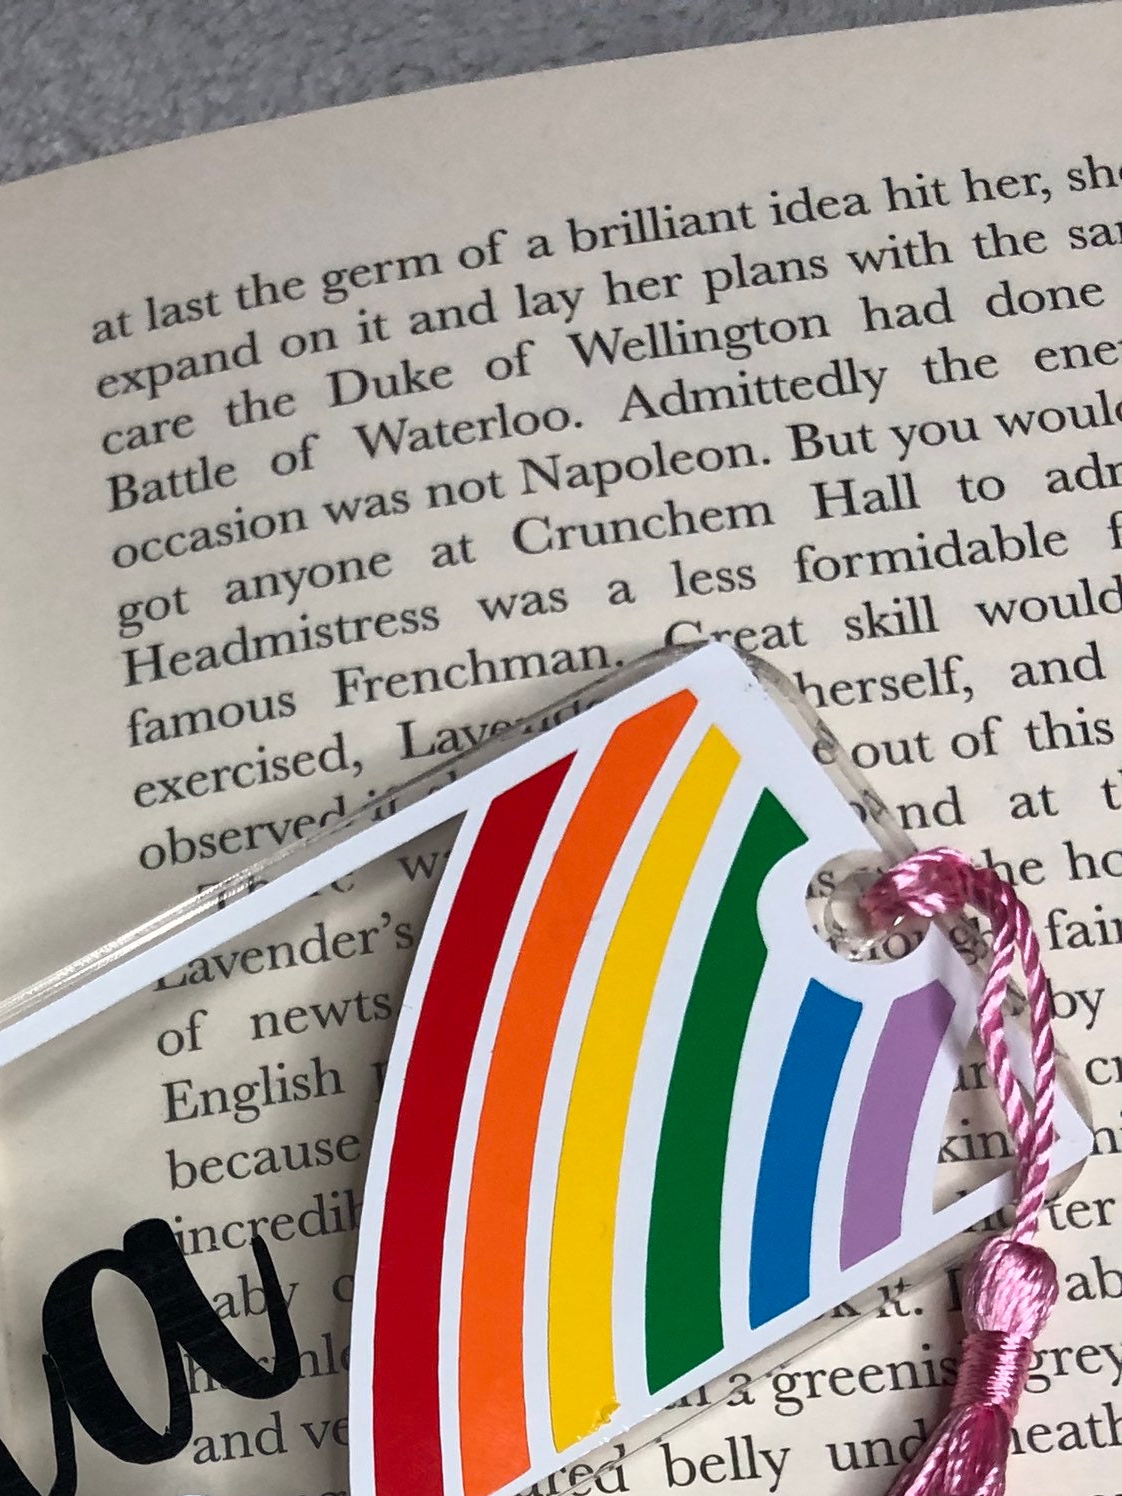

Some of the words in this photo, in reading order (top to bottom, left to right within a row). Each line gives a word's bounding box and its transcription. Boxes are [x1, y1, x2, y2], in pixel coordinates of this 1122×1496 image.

[96, 329, 262, 401] expand
[514, 282, 585, 324] lay
[701, 252, 829, 305] plans
[846, 229, 954, 275] with
[971, 222, 1048, 260] the
[144, 290, 222, 332] last
[321, 252, 443, 305] germ
[565, 201, 757, 253] brilliant
[769, 186, 872, 226] idea
[881, 172, 951, 213] hit
[960, 167, 1052, 204] her,
[101, 414, 194, 455] care
[326, 358, 453, 408] Duke
[566, 314, 831, 368] Wellington
[858, 286, 956, 332] had
[985, 279, 1105, 318] done
[106, 455, 237, 513] Battle
[353, 402, 583, 459] Waterloo.
[618, 357, 888, 423] Admittedly
[921, 345, 999, 385] the
[111, 506, 309, 569] occasion
[321, 489, 411, 525] was
[425, 470, 506, 509] not
[517, 440, 771, 498] Napoleon.
[785, 422, 877, 462] But
[889, 417, 981, 462] you
[118, 586, 189, 639] got
[225, 552, 392, 606] anyone
[512, 499, 776, 555] Crunchem
[809, 472, 921, 521] Hall
[118, 600, 443, 708] Headmistress
[477, 587, 569, 622] was
[670, 559, 757, 598] less
[794, 520, 1069, 584] formidable
[127, 692, 297, 748] famous
[332, 643, 626, 710] Frenchman.
[844, 594, 940, 642] skill
[133, 731, 363, 808] exercised,
[792, 654, 974, 709] herself,
[1010, 639, 1107, 688] and
[851, 731, 935, 769] out
[1024, 706, 1115, 752] this
[157, 1008, 209, 1057] of
[249, 990, 396, 1041] newts
[161, 1056, 346, 1124] English
[165, 1134, 362, 1191] because
[658, 1434, 791, 1494] belly
